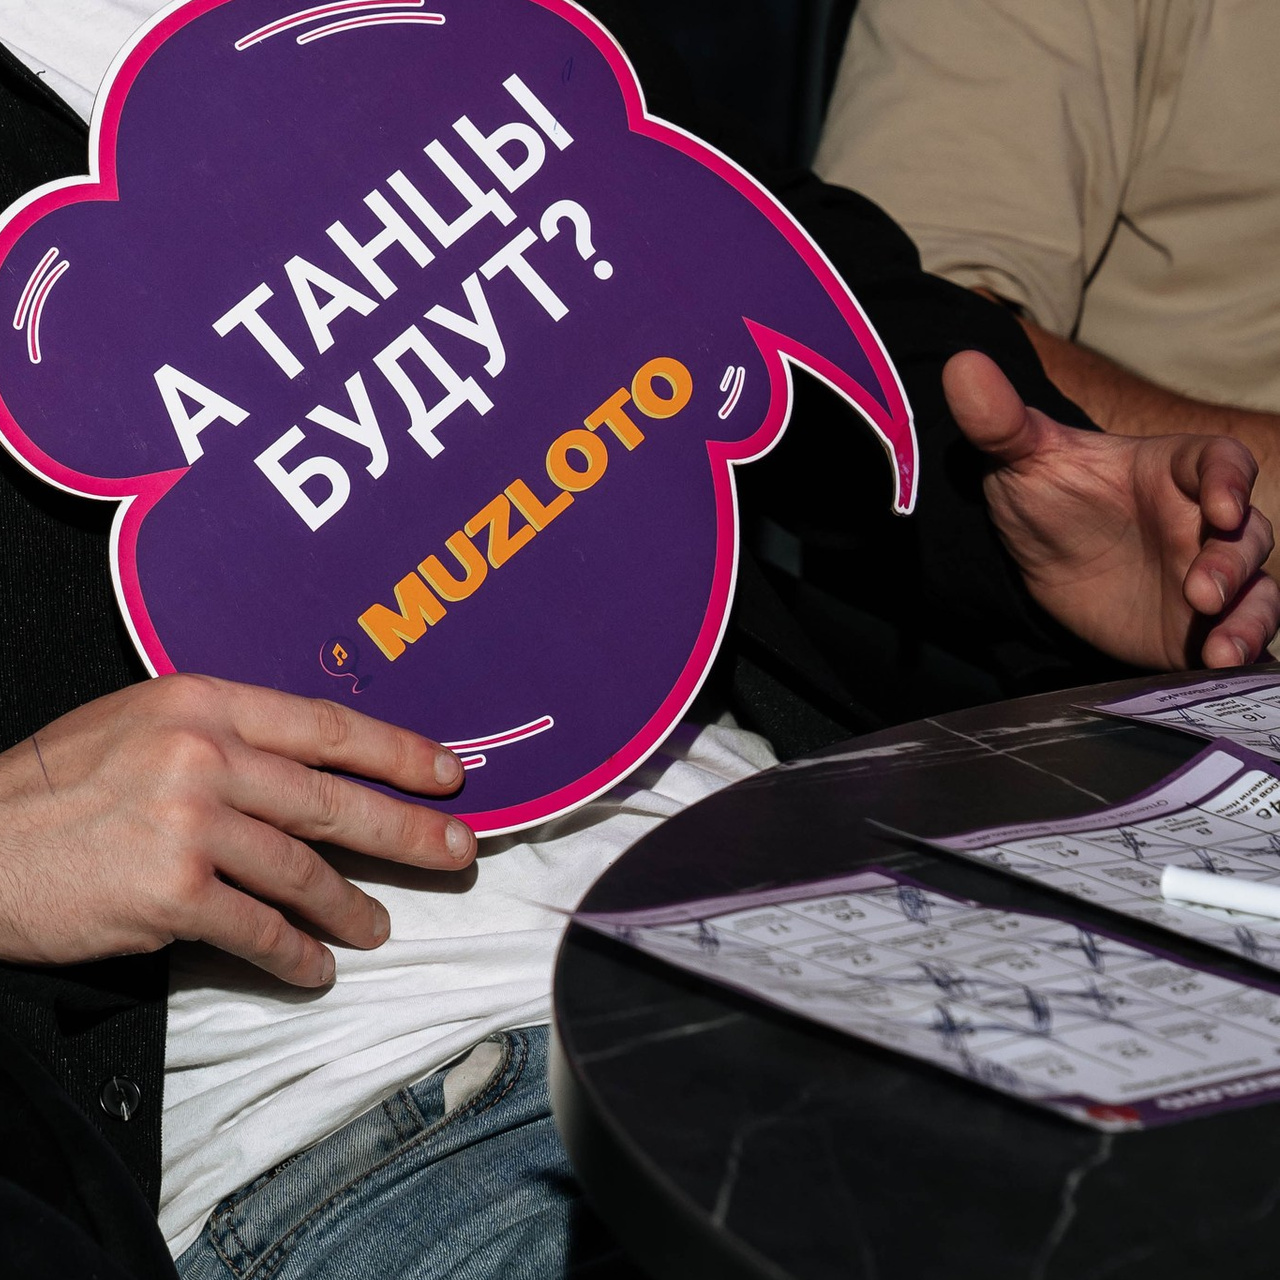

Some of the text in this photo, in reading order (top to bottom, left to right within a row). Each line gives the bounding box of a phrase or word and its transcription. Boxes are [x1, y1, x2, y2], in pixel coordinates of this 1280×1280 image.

[153, 73, 574, 466] А ТАНЦЫ
[253, 199, 614, 532] БУДУТ?
[357, 356, 693, 662] MUZLOTO
[1242, 711, 1266, 722] 16
